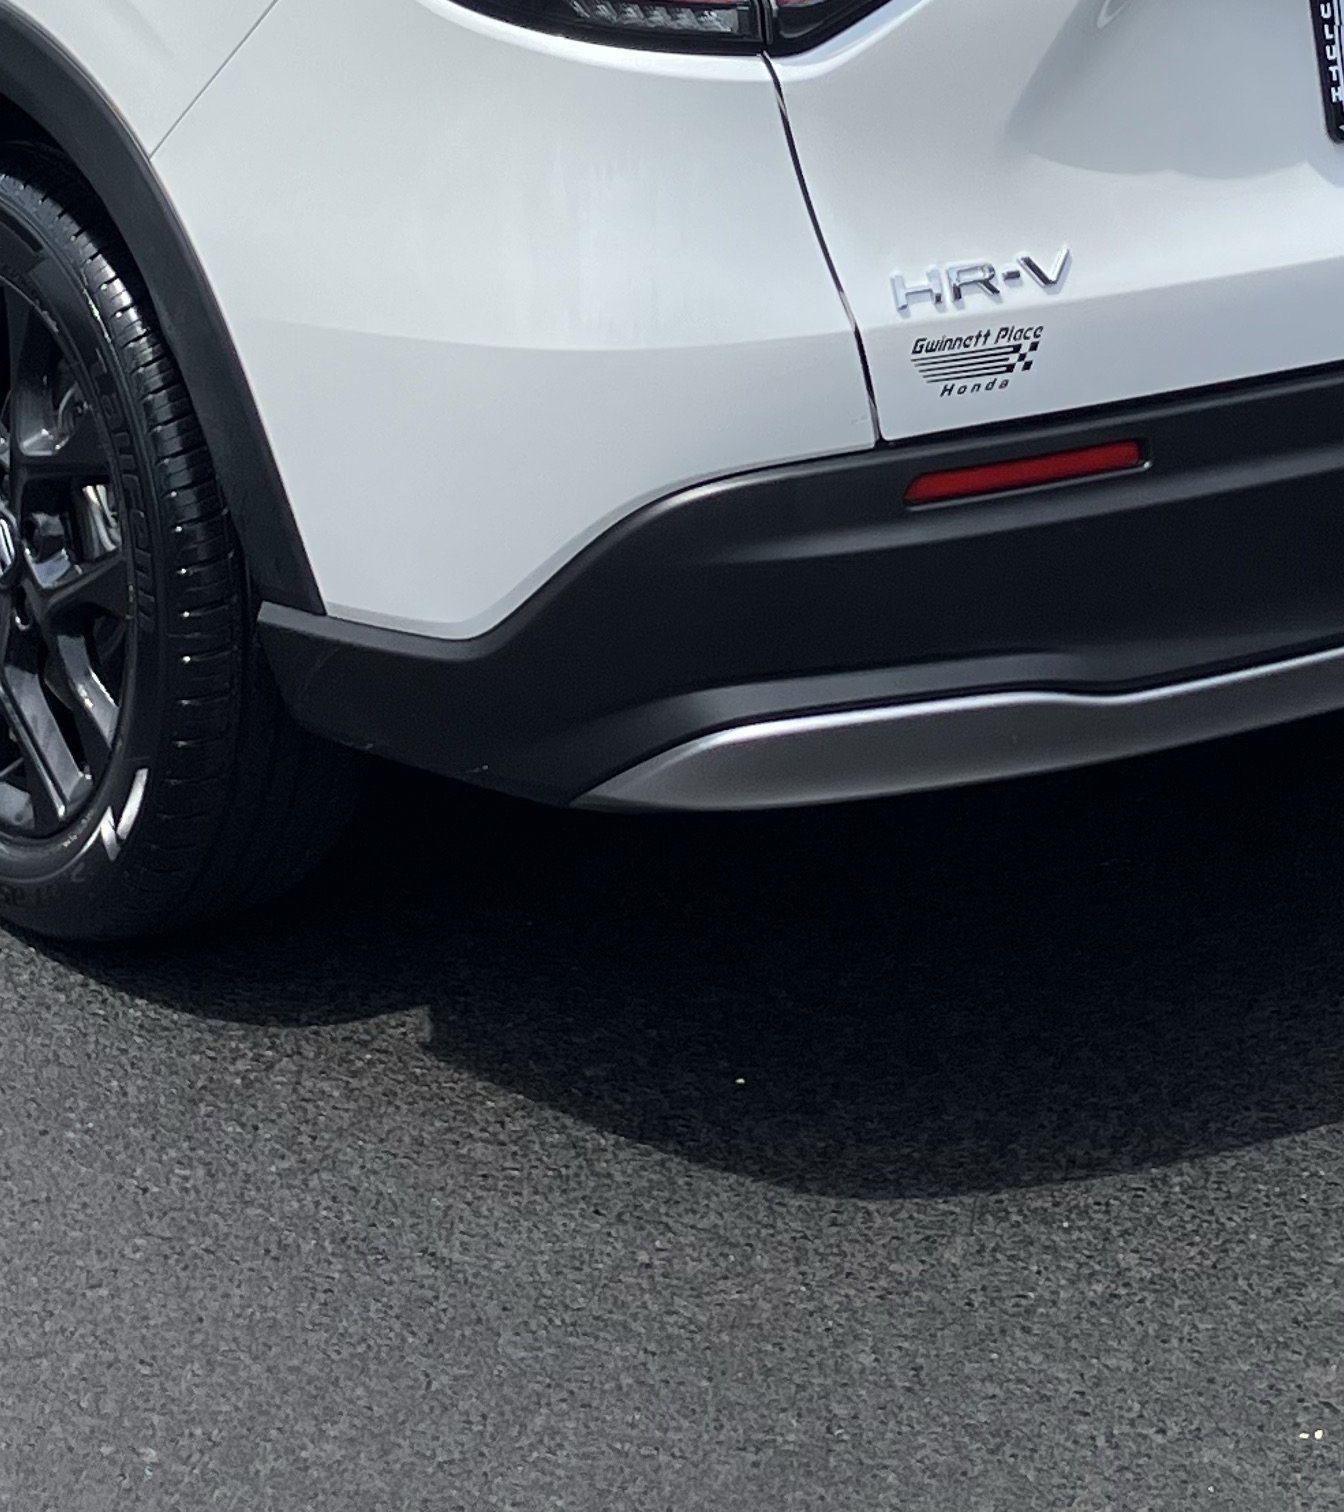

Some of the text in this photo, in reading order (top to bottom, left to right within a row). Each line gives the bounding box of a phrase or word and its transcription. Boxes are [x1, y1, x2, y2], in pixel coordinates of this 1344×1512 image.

[889, 246, 1071, 312] HR-V
[911, 325, 1044, 355] Gwinnett Place
[940, 377, 1010, 398] Honda
